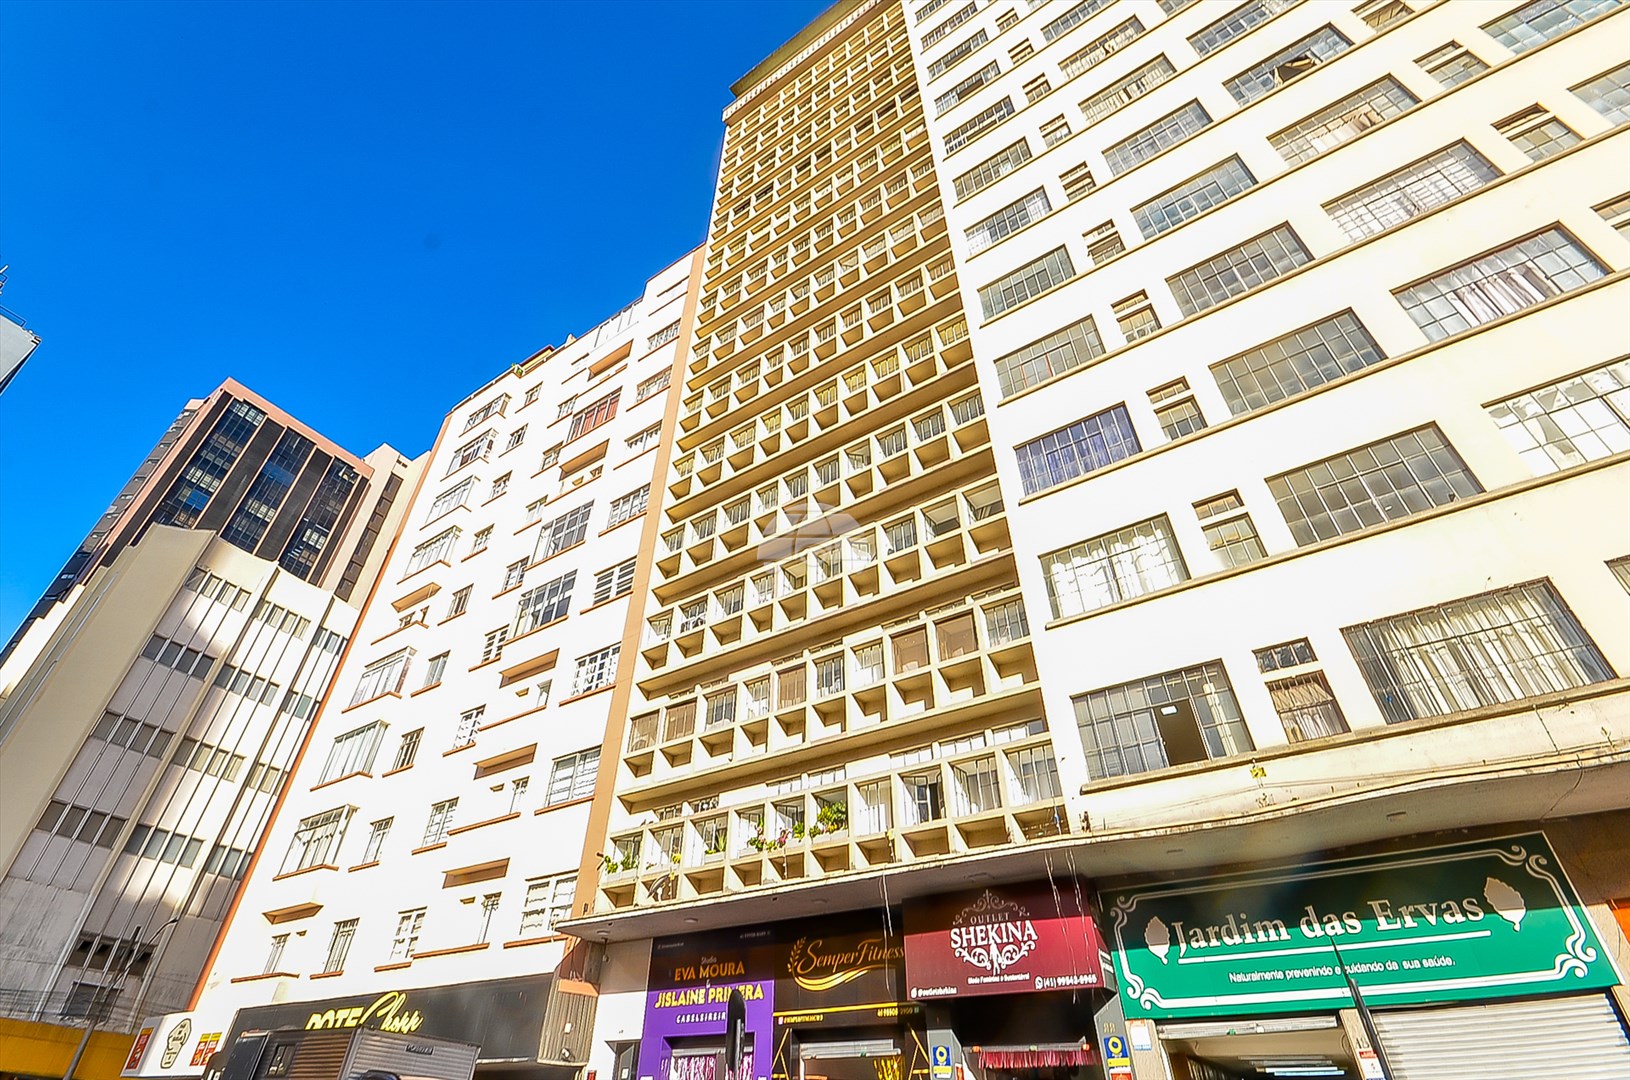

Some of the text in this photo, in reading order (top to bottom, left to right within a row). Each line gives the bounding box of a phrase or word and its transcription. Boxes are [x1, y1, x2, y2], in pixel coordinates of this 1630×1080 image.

[970, 912, 1009, 925] OUTLET
[1171, 898, 1485, 958] Jardim das Ervas
[950, 920, 1037, 949] SHEKINA
[674, 961, 745, 981] EVA MOURA
[1228, 969, 1284, 984] Naturalmente
[1285, 964, 1333, 981] prevenindo
[1385, 960, 1399, 971] da
[1403, 958, 1421, 970] sua
[1422, 955, 1456, 969] saúde.
[654, 988, 706, 1008] JISLAINE
[676, 1011, 726, 1024] CABELEIREIR
